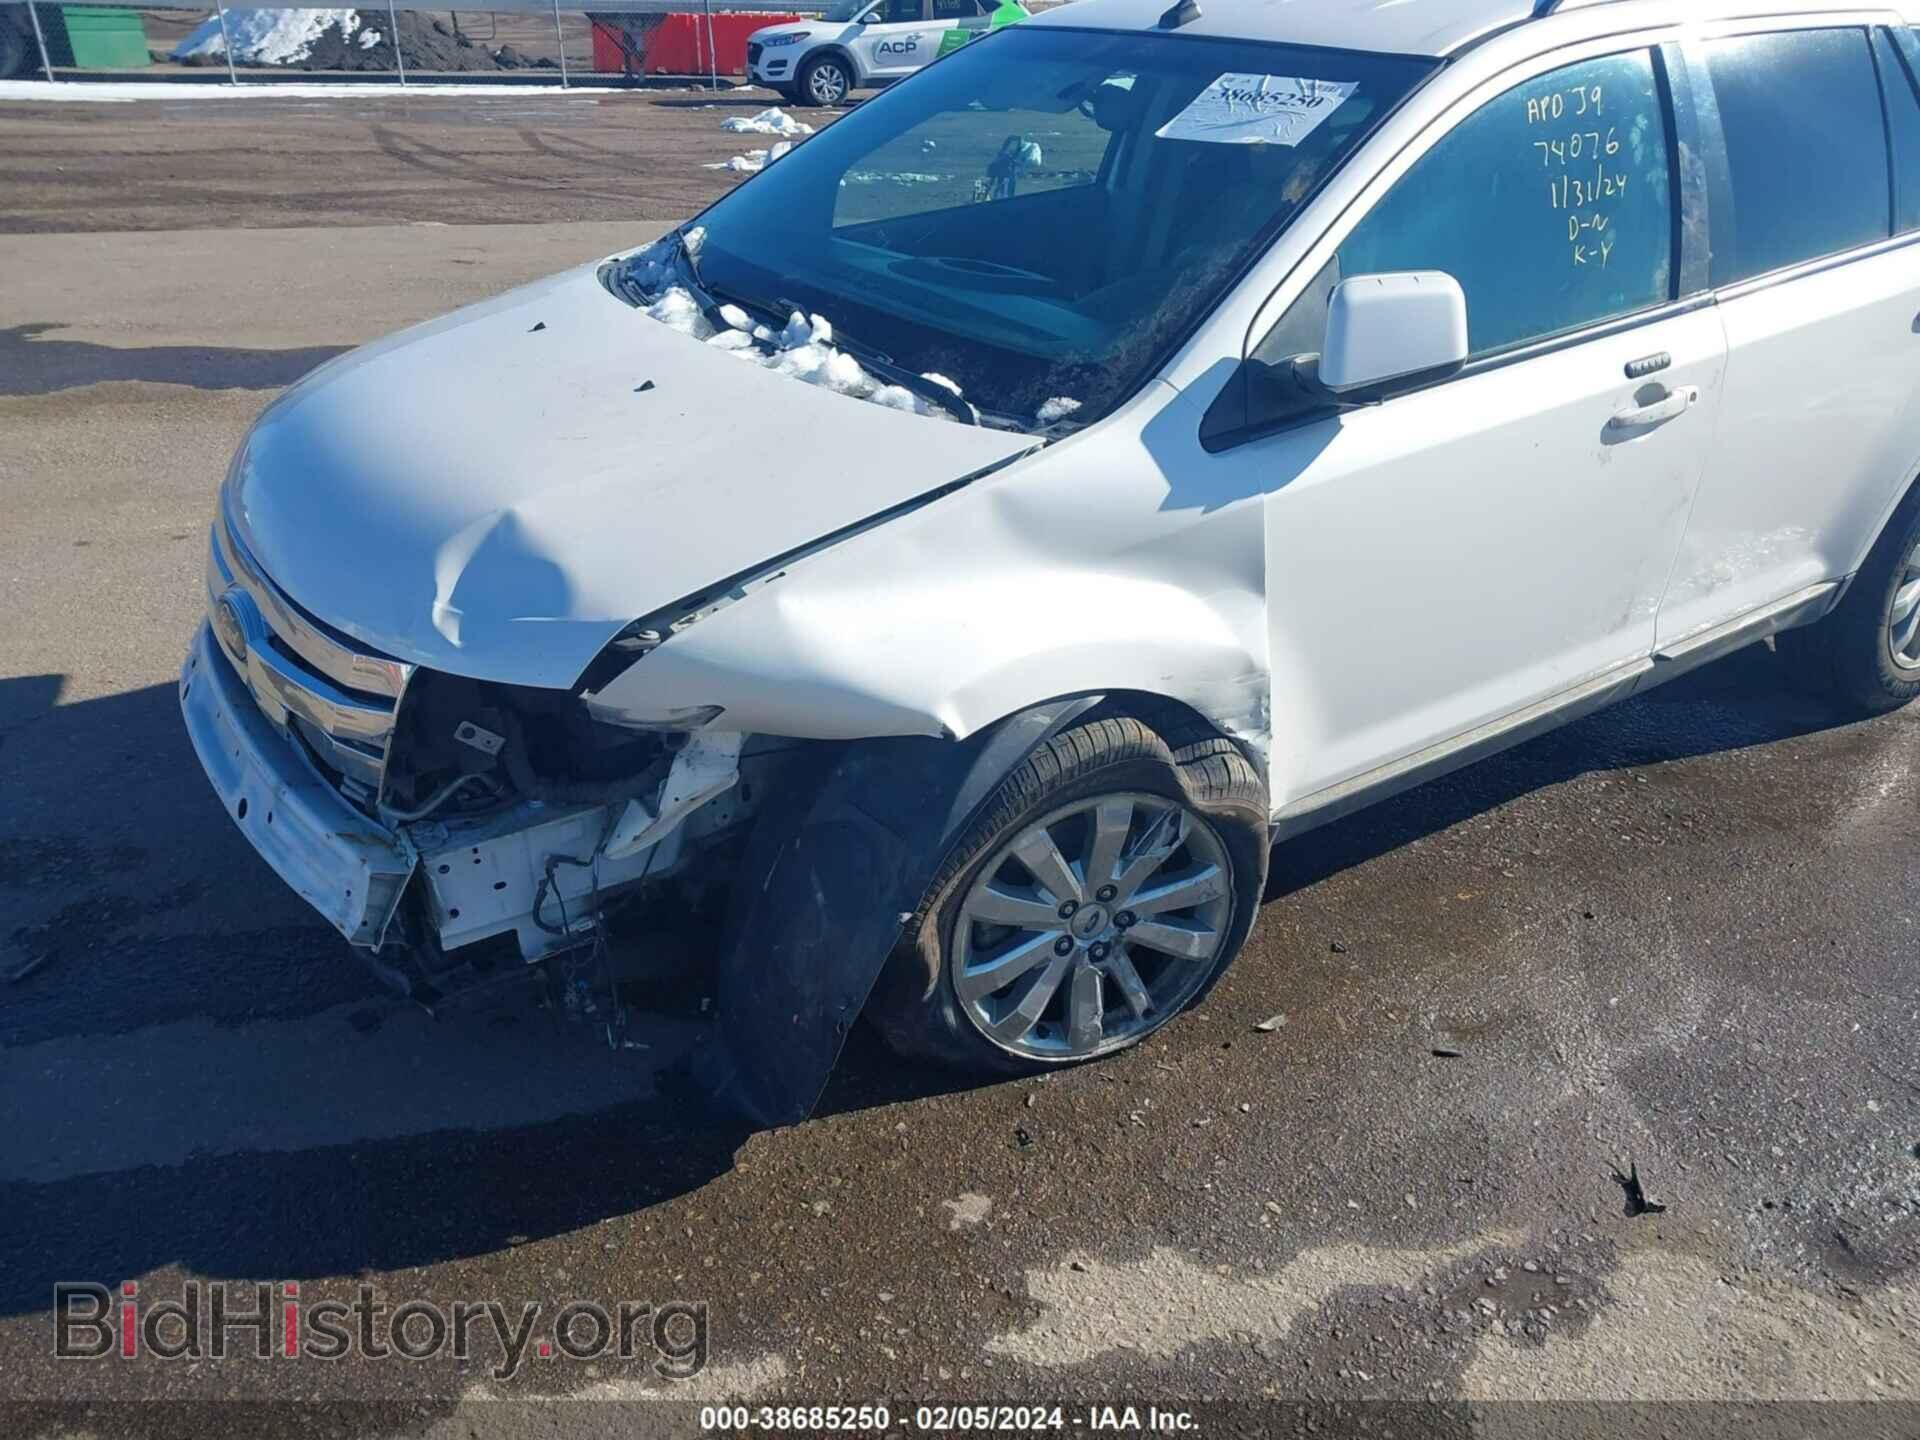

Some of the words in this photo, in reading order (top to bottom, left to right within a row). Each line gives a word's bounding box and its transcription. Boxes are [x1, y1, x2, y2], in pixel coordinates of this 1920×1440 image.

[879, 41, 917, 54] ACP
[1570, 86, 1602, 117] J9
[1533, 126, 1619, 167] 74076
[1551, 163, 1627, 209] 1/31/24
